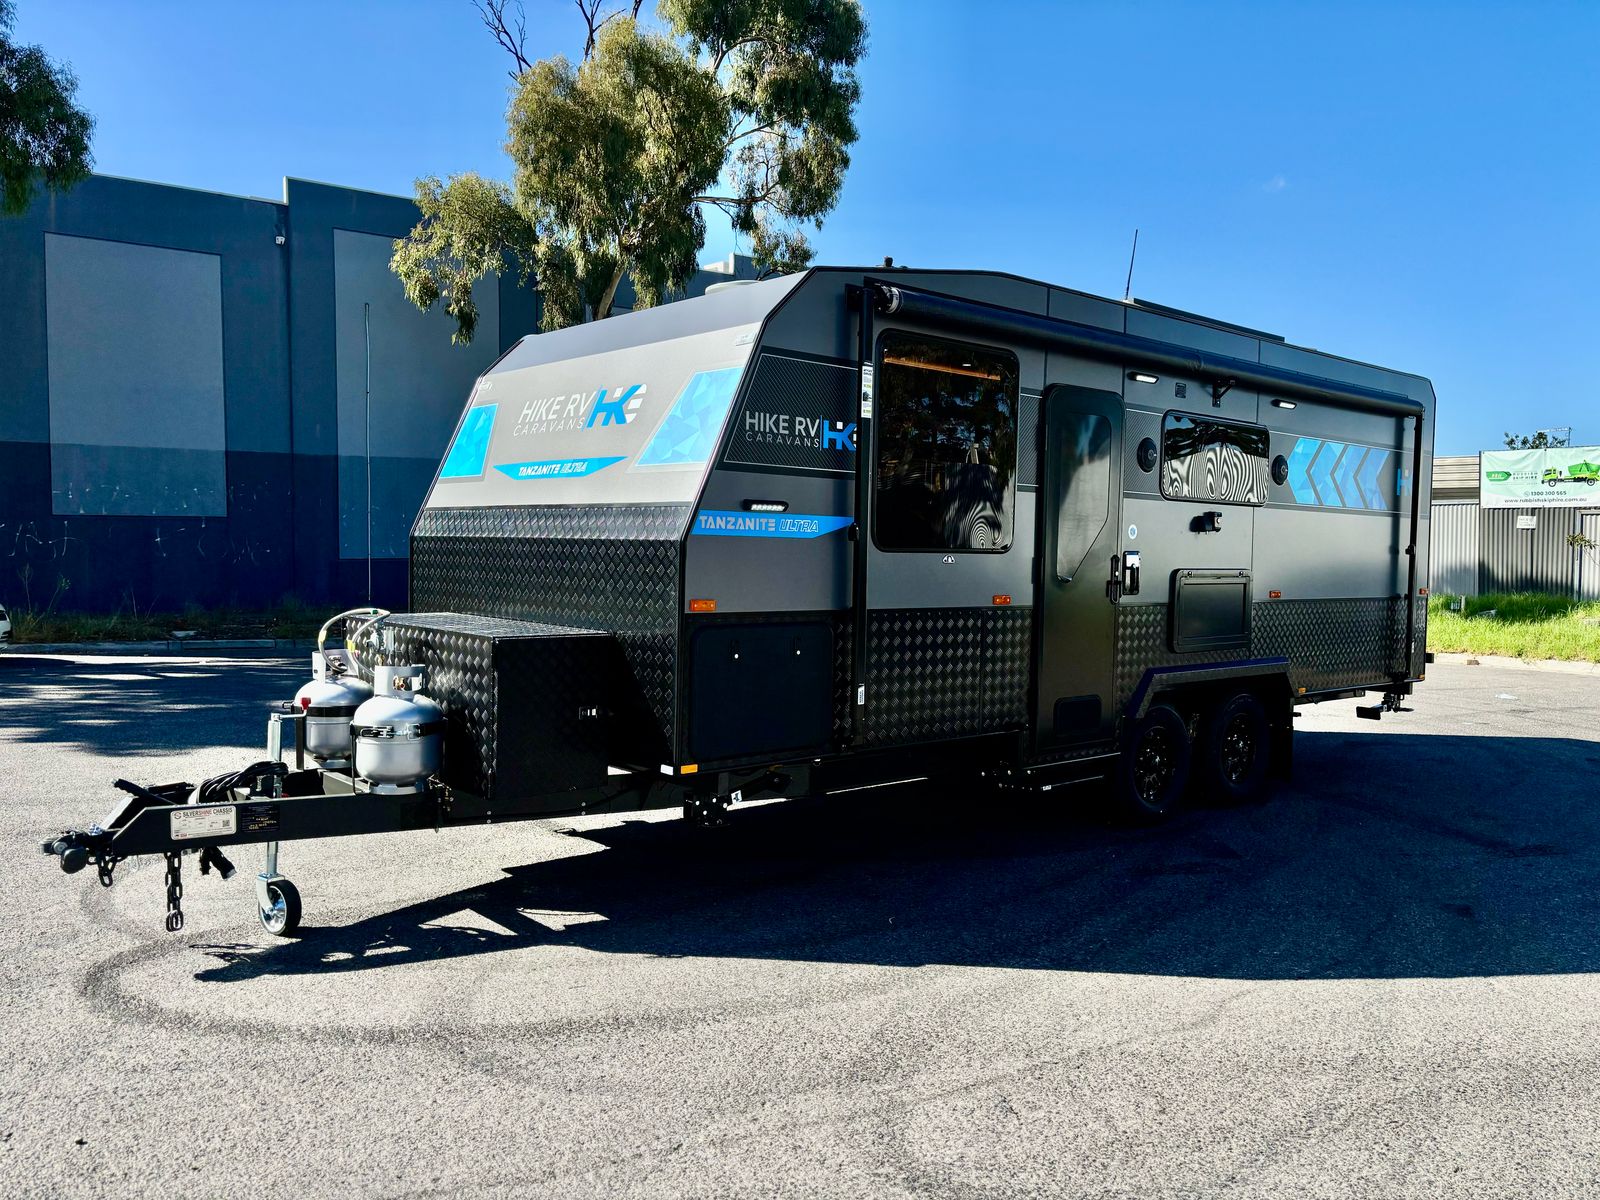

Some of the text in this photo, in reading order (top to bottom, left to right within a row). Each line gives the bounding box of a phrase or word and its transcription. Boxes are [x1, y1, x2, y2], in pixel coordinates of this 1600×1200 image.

[518, 391, 597, 423] HIKE RV
[513, 418, 586, 437] CARAVANS
[745, 411, 820, 438] HIKE RV
[745, 431, 820, 448] CARAVANS
[518, 461, 589, 477] TANZANITE ULTRA
[700, 515, 819, 532] TANZANITE ULTRA
[182, 807, 233, 817] SILVERSHINE CHASSIS
